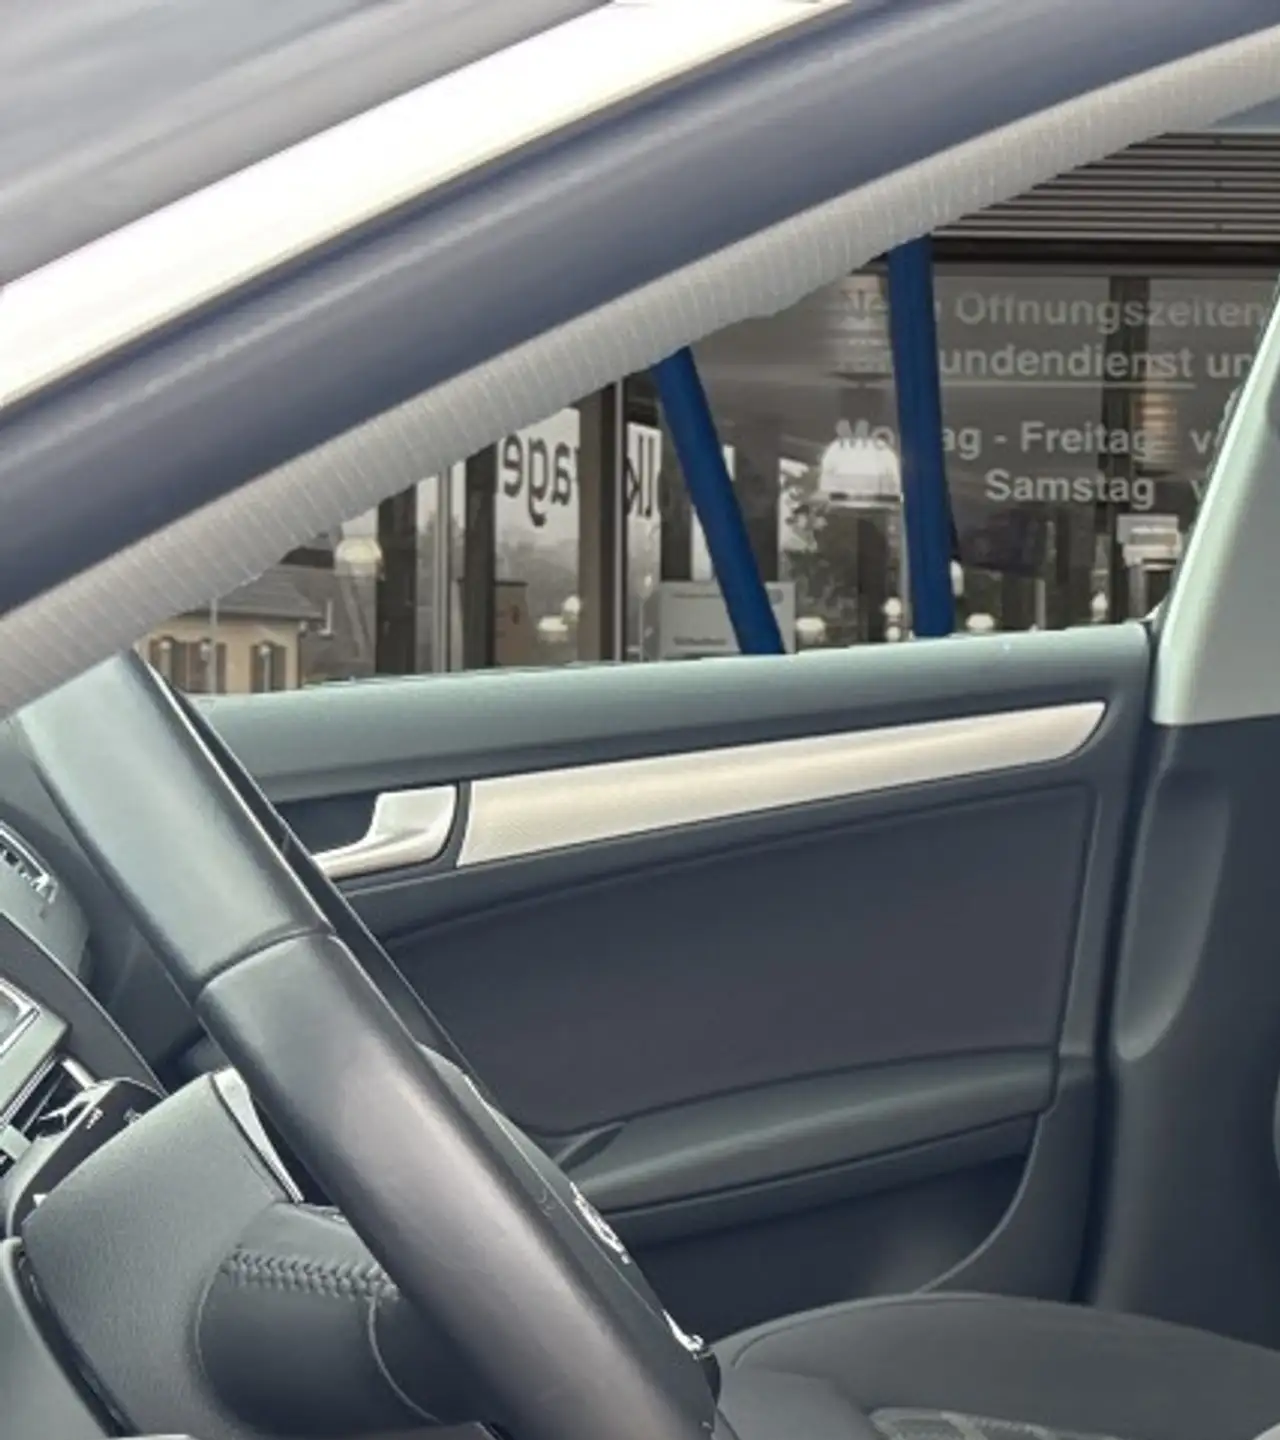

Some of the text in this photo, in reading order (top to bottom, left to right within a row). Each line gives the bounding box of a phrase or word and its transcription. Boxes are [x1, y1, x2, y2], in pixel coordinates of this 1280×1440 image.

[941, 343, 1253, 378] undendienst un
[1020, 421, 1154, 462] Freitag
[984, 469, 1154, 511] Samstag
